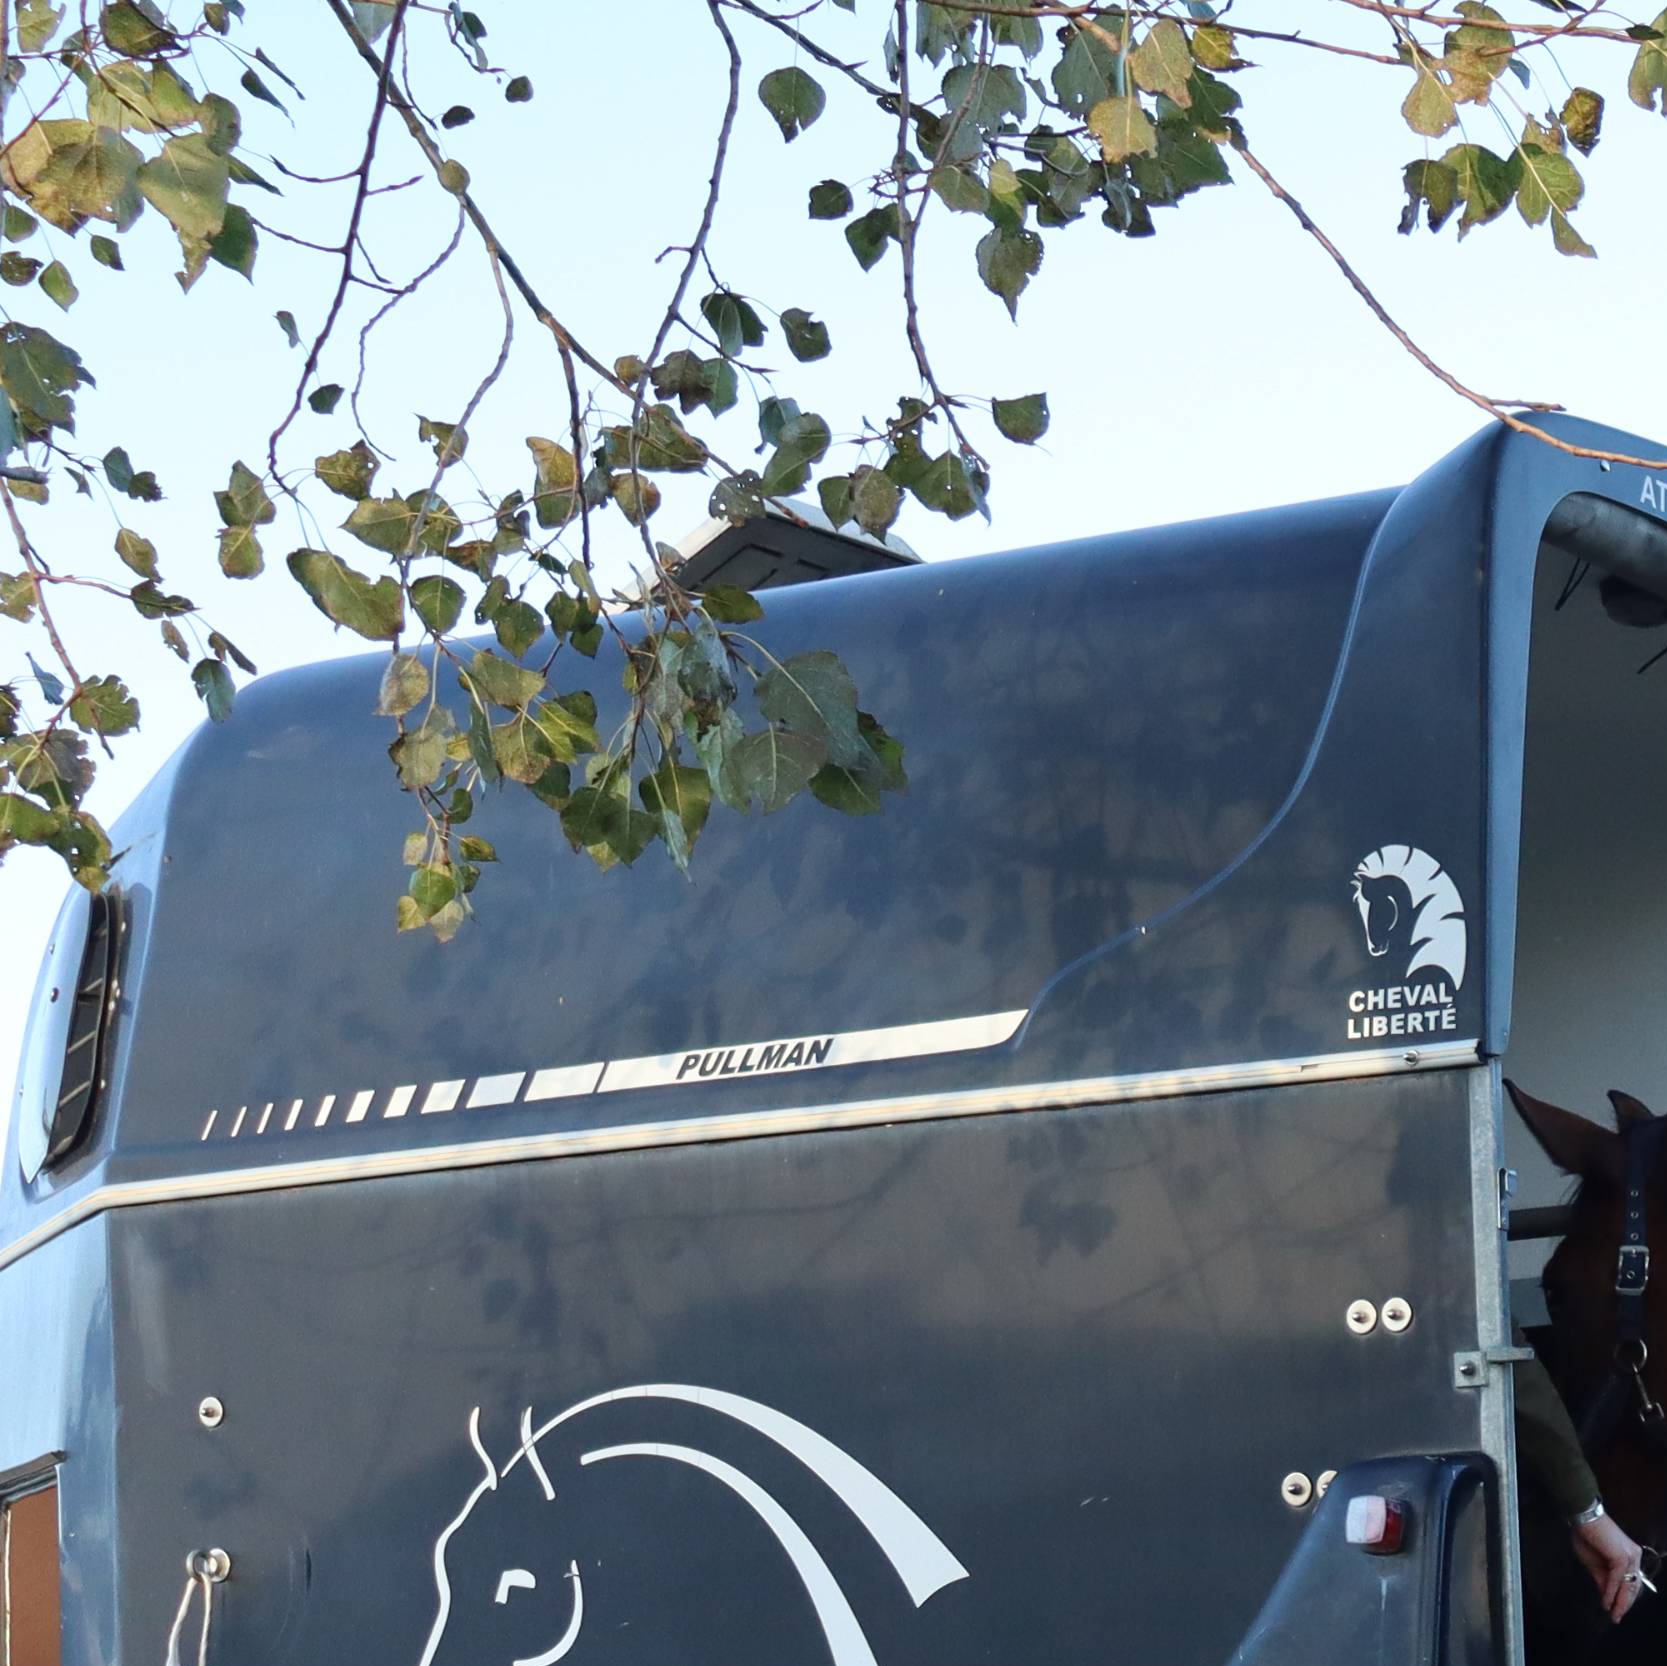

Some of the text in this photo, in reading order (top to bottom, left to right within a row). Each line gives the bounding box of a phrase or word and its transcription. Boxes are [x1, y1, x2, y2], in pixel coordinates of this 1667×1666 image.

[1348, 982, 1454, 1013] CHEVAL
[1347, 1003, 1457, 1040] LIBERTÉ
[676, 1037, 834, 1080] PULLMAN
